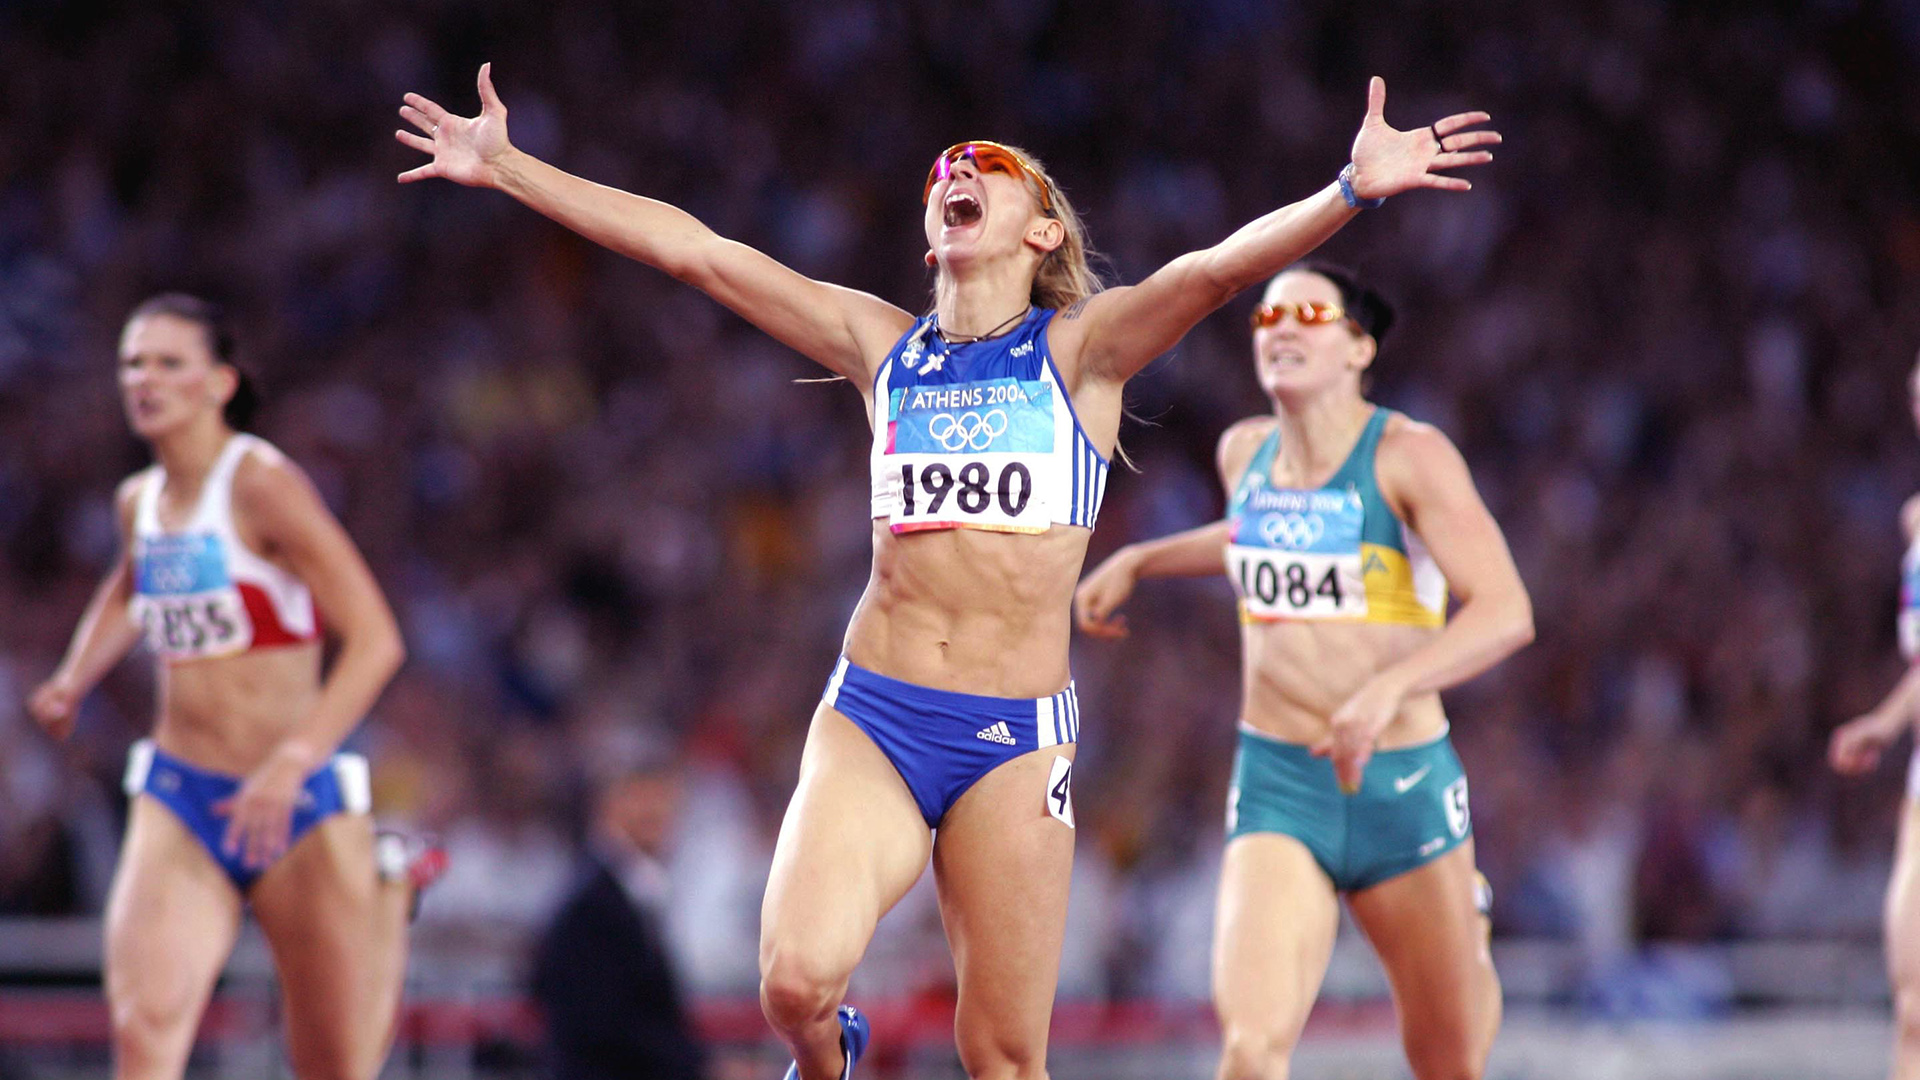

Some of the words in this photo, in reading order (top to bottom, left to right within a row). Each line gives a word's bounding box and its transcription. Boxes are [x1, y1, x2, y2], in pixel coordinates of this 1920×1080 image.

[912, 388, 983, 410] ATHENS
[987, 384, 1028, 404] 2004
[902, 461, 1032, 518] 1980
[1241, 559, 1343, 609] 1084
[976, 731, 1016, 745] adidas
[1051, 764, 1071, 816] 4
[1454, 788, 1467, 830] 5
